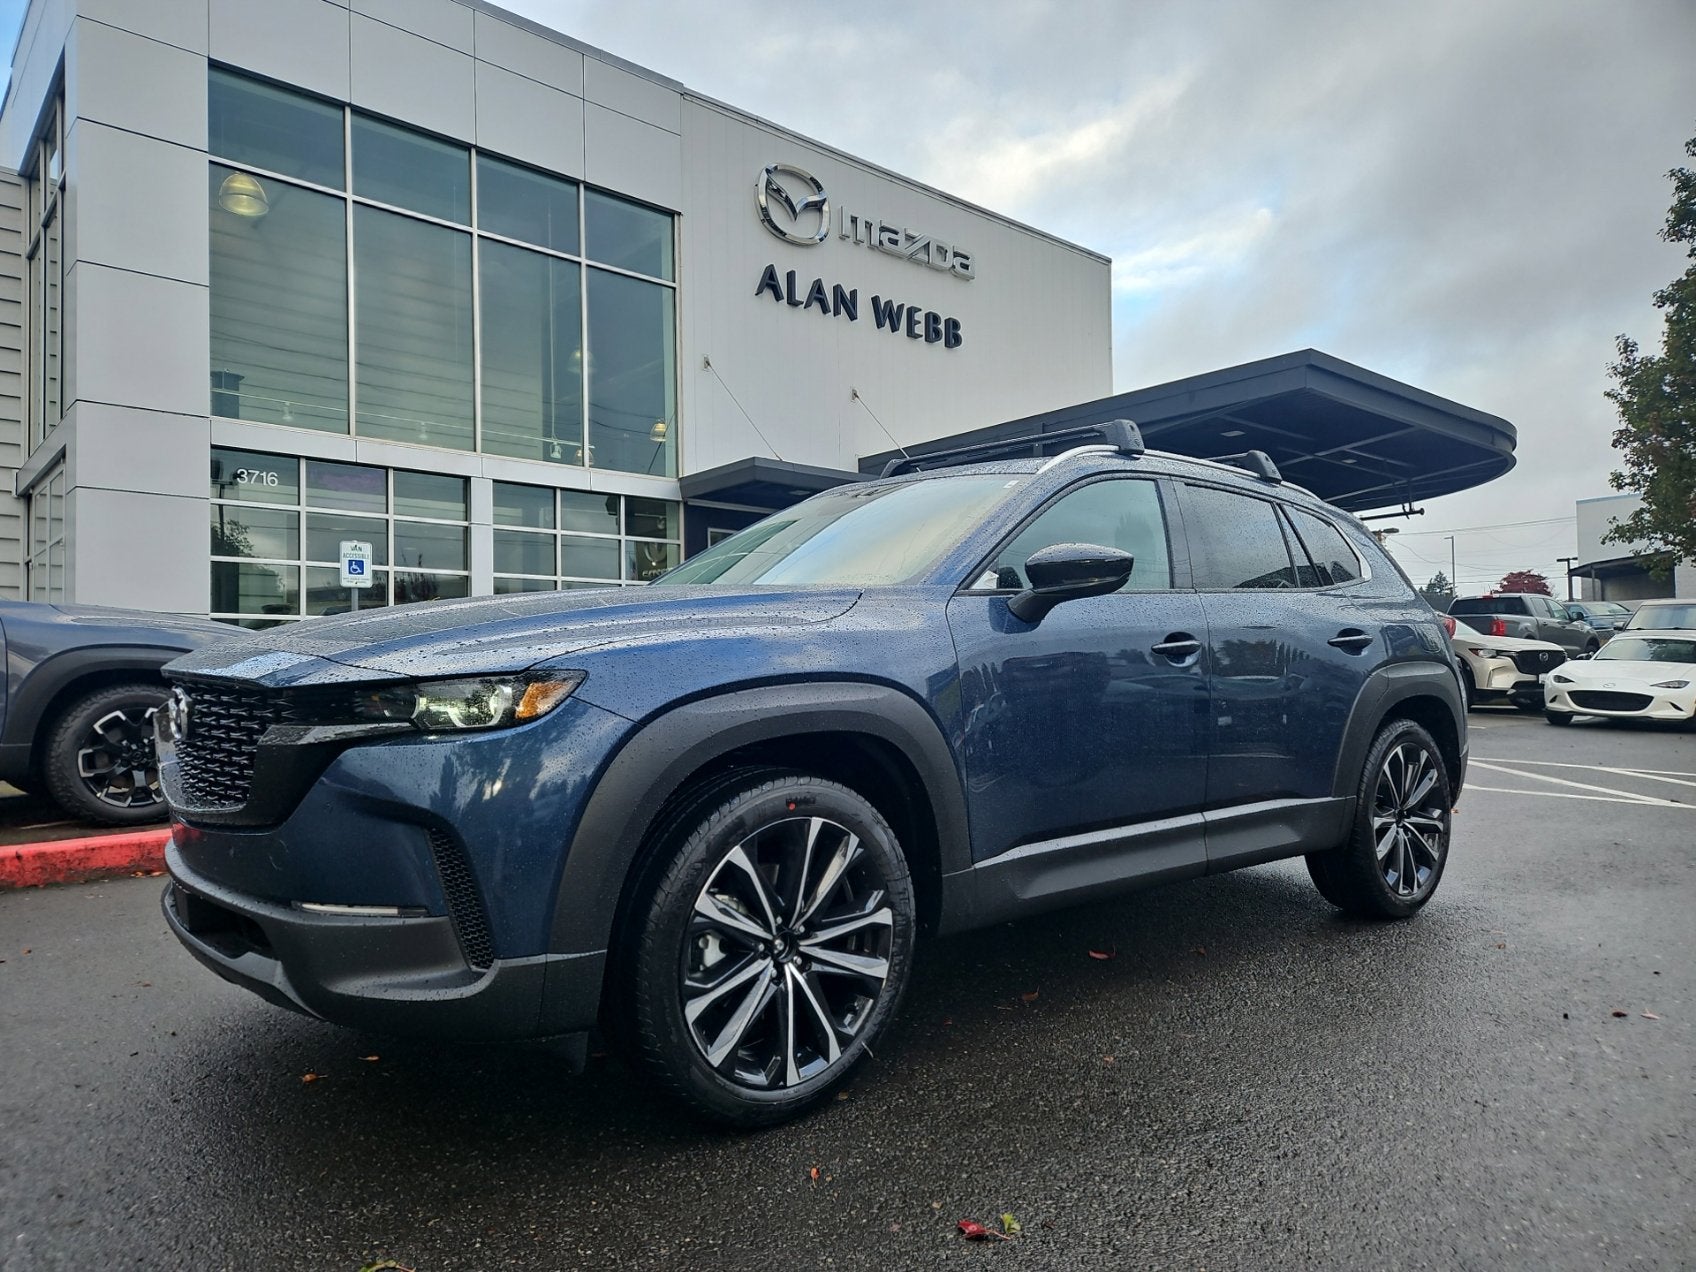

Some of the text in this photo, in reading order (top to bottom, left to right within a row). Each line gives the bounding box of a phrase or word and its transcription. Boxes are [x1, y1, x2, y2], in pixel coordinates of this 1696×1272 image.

[755, 263, 963, 349] ALAN WEBB
[236, 468, 279, 487] 3716
